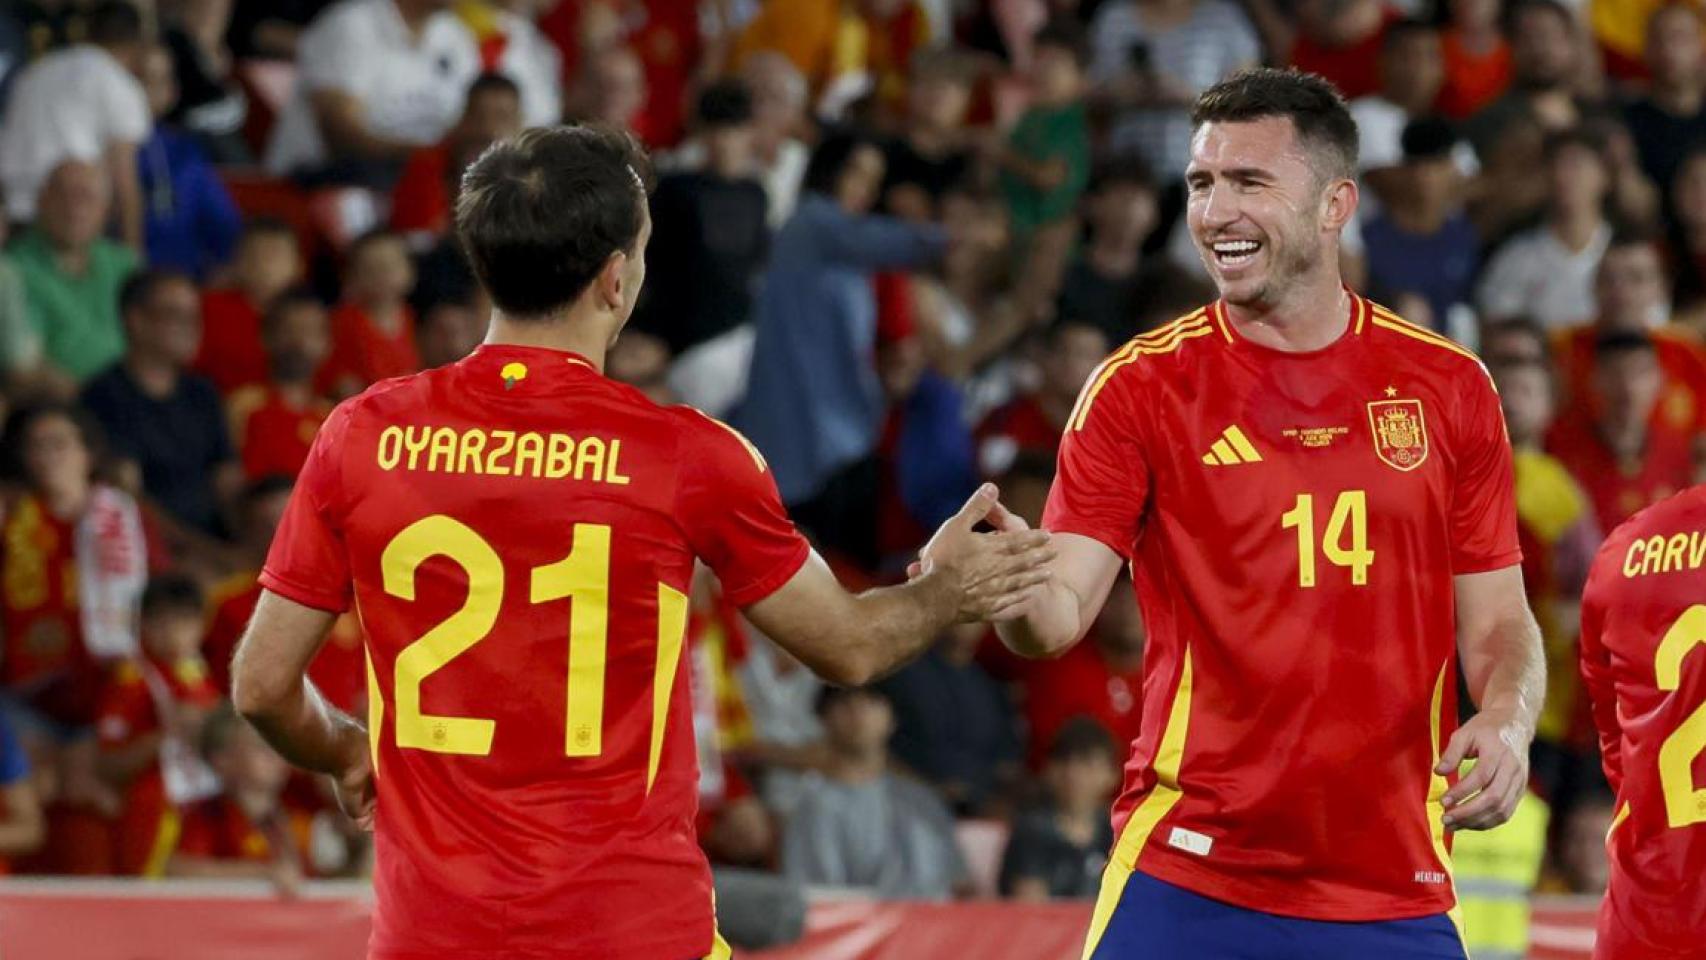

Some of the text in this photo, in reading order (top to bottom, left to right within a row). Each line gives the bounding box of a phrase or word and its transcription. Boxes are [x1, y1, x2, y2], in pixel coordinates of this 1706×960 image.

[377, 425, 630, 485] OYARZABAL
[1281, 490, 1375, 587] 14
[380, 514, 611, 757] 21
